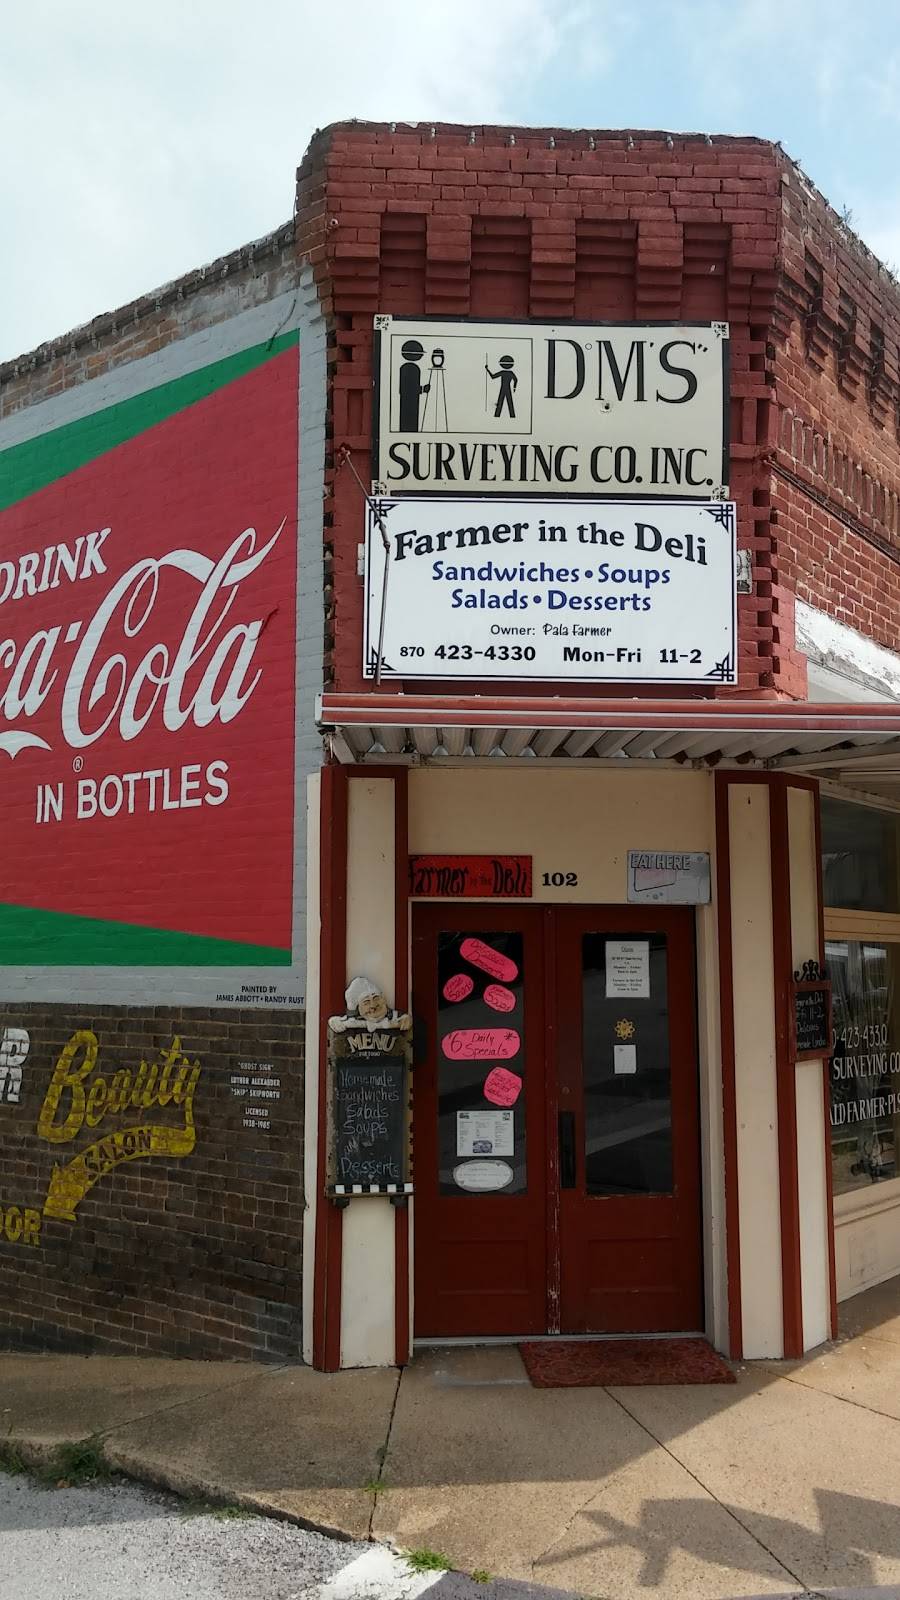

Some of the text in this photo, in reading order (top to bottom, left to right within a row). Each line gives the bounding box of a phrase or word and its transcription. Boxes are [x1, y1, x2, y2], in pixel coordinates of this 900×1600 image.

[387, 442, 713, 486] SURVEYING CO. INC.
[394, 519, 707, 565] Farmer in the Deli
[432, 561, 670, 588] Sandwiches Soups
[451, 589, 651, 611] Salads Desserts
[490, 624, 535, 636] Owner:
[572, 624, 612, 637] Farmer
[400, 645, 702, 663] 870 423-4330 Mon-Fri 11-2
[35, 760, 229, 824] IN BOTTLES
[630, 853, 691, 871] EAT HERE
[408, 855, 469, 894] Farmer
[491, 860, 527, 894] Deli
[541, 872, 578, 887] 102
[264, 996, 287, 1004] RANDY
[289, 996, 304, 1004] RUST
[347, 1032, 397, 1053] MENU
[450, 1033, 462, 1053] 6
[833, 1052, 888, 1080] SURVEYING
[38, 1030, 201, 1143] Beauty
[347, 1103, 388, 1120] Salads
[847, 1097, 885, 1122] FARMER
[343, 1120, 387, 1141] Soups
[0, 1206, 41, 1246] OR
